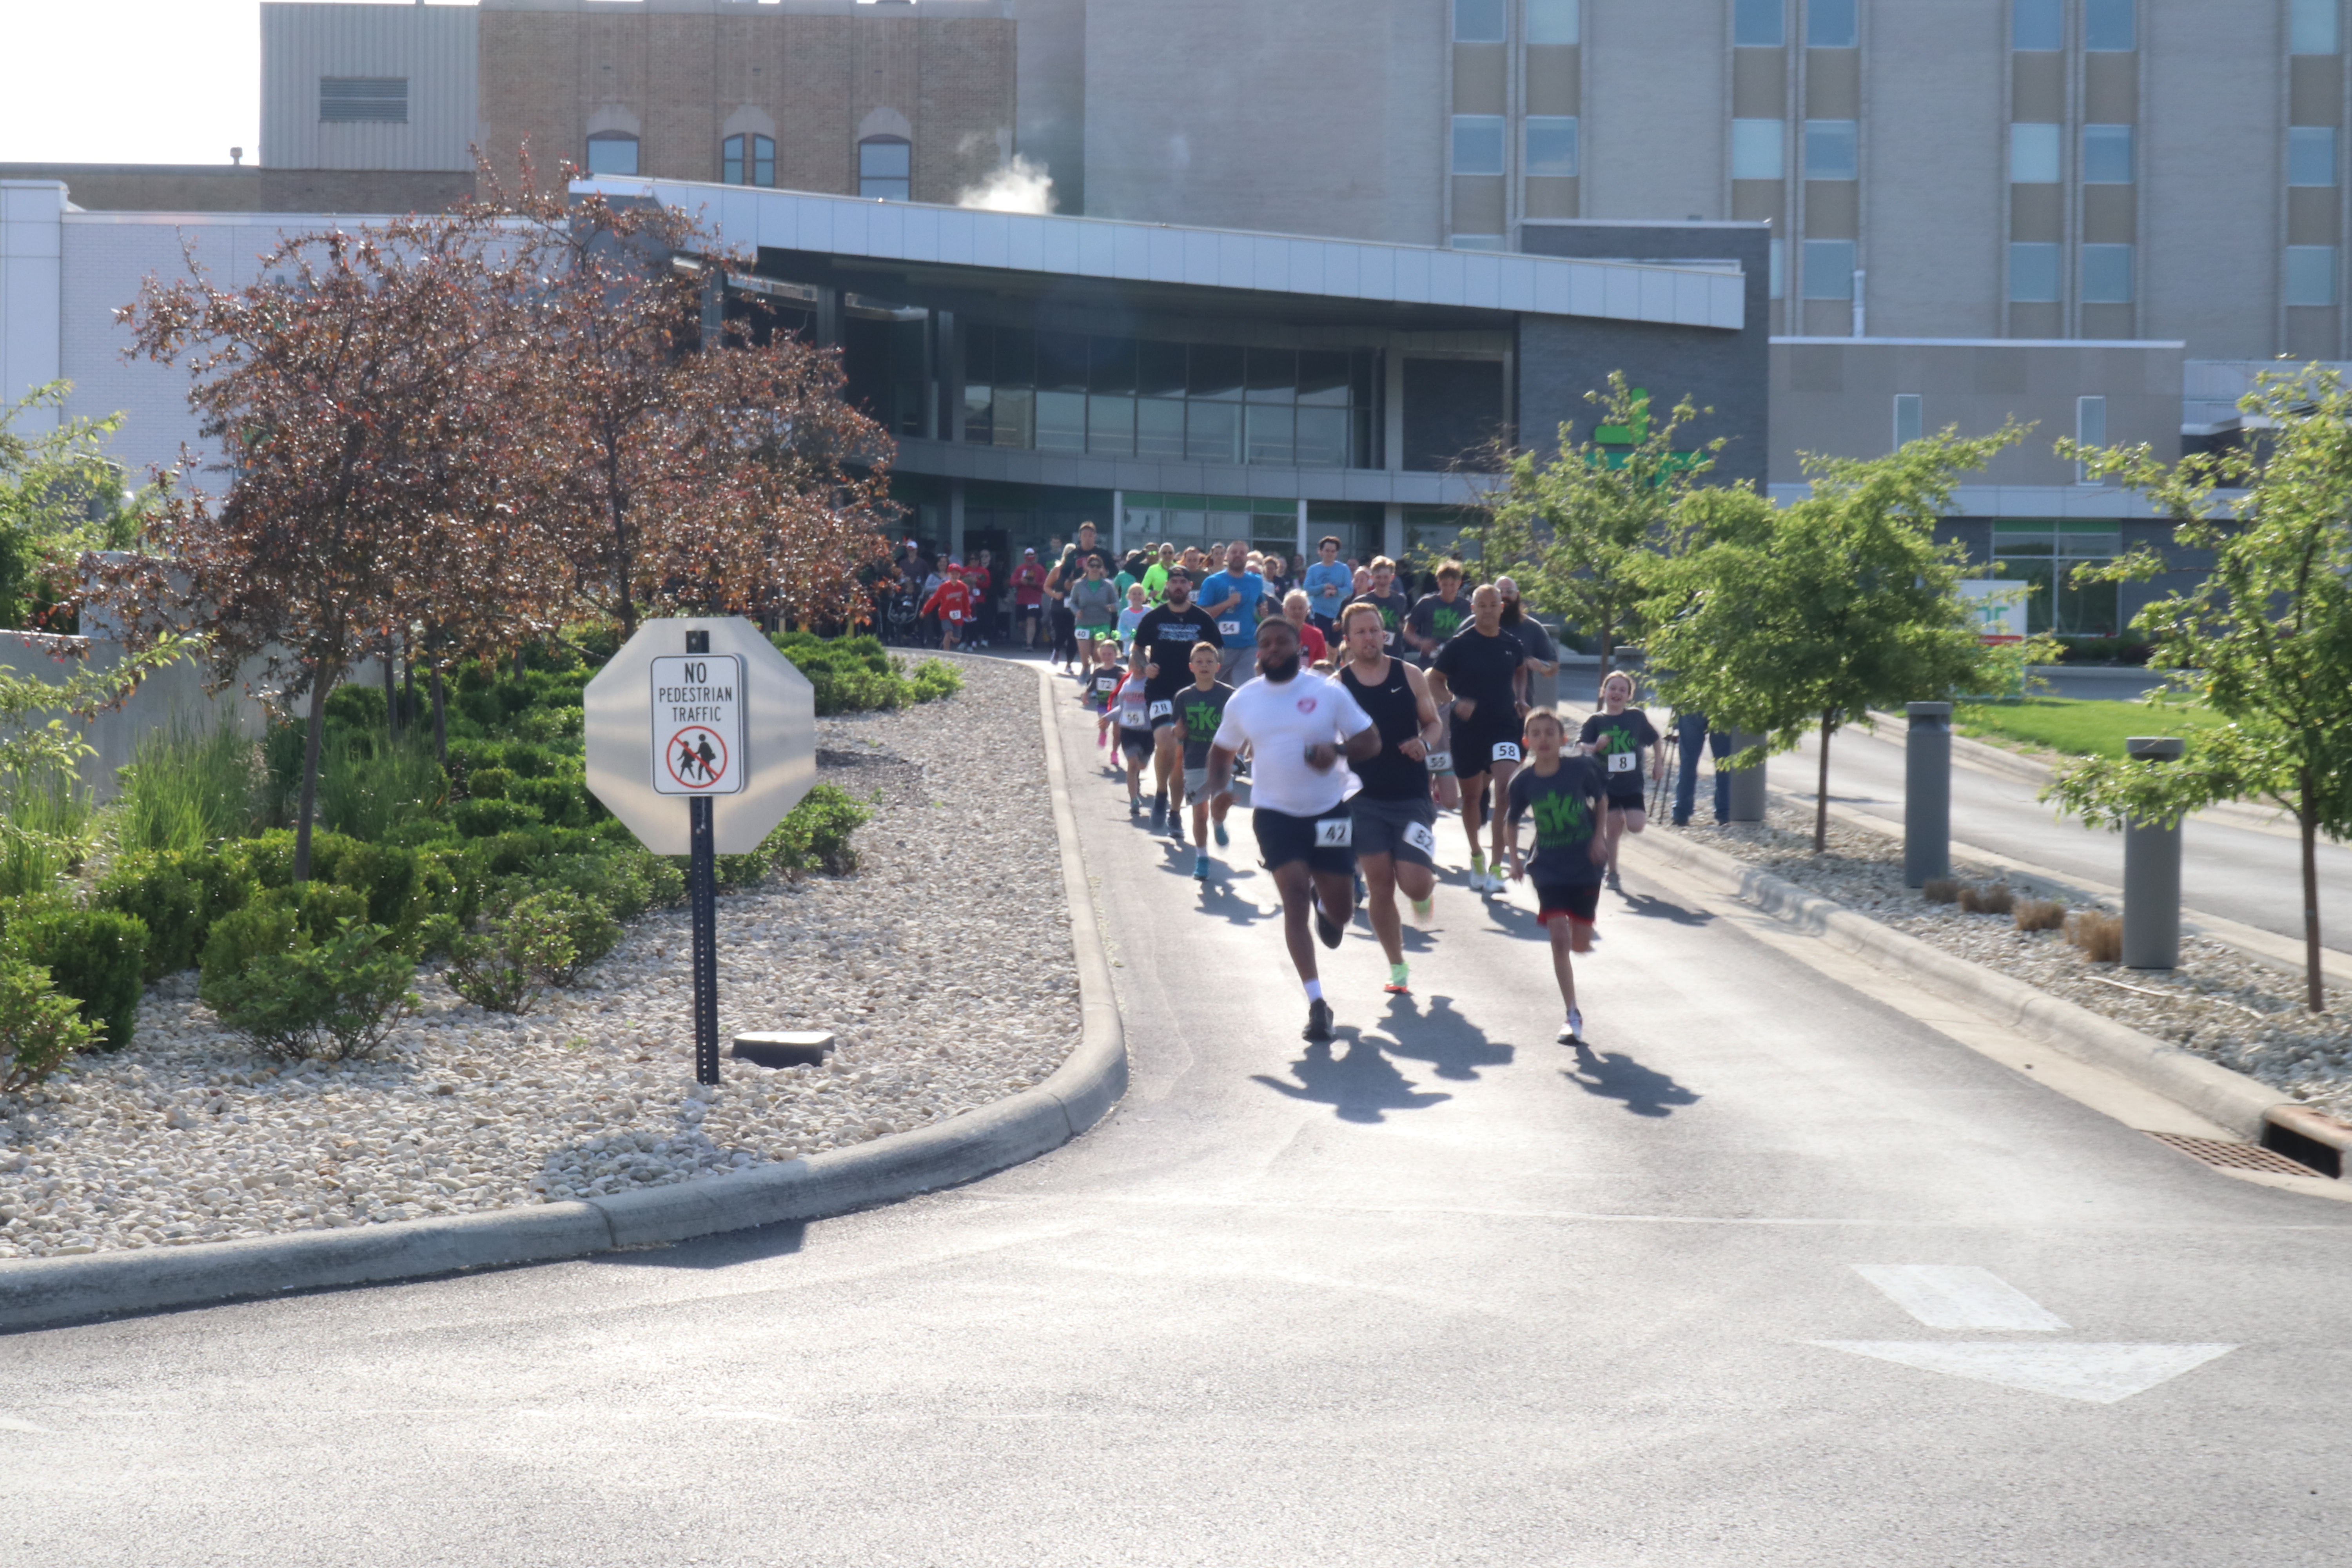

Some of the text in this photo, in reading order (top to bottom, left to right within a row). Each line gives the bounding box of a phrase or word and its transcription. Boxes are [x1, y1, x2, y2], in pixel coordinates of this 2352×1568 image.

[1433, 607, 1459, 629] 5K
[1222, 623, 1235, 632] 54
[684, 662, 707, 684] NO
[1100, 680, 1112, 688] 72
[659, 687, 733, 703] PEDESTRIAN
[672, 707, 721, 722] TRAFFIC
[1152, 703, 1168, 714] 28
[1185, 701, 1218, 730] 5K
[1499, 746, 1516, 757] 58
[1619, 757, 1627, 769] 8
[1530, 789, 1581, 833] 5K
[1325, 824, 1346, 841] 42
